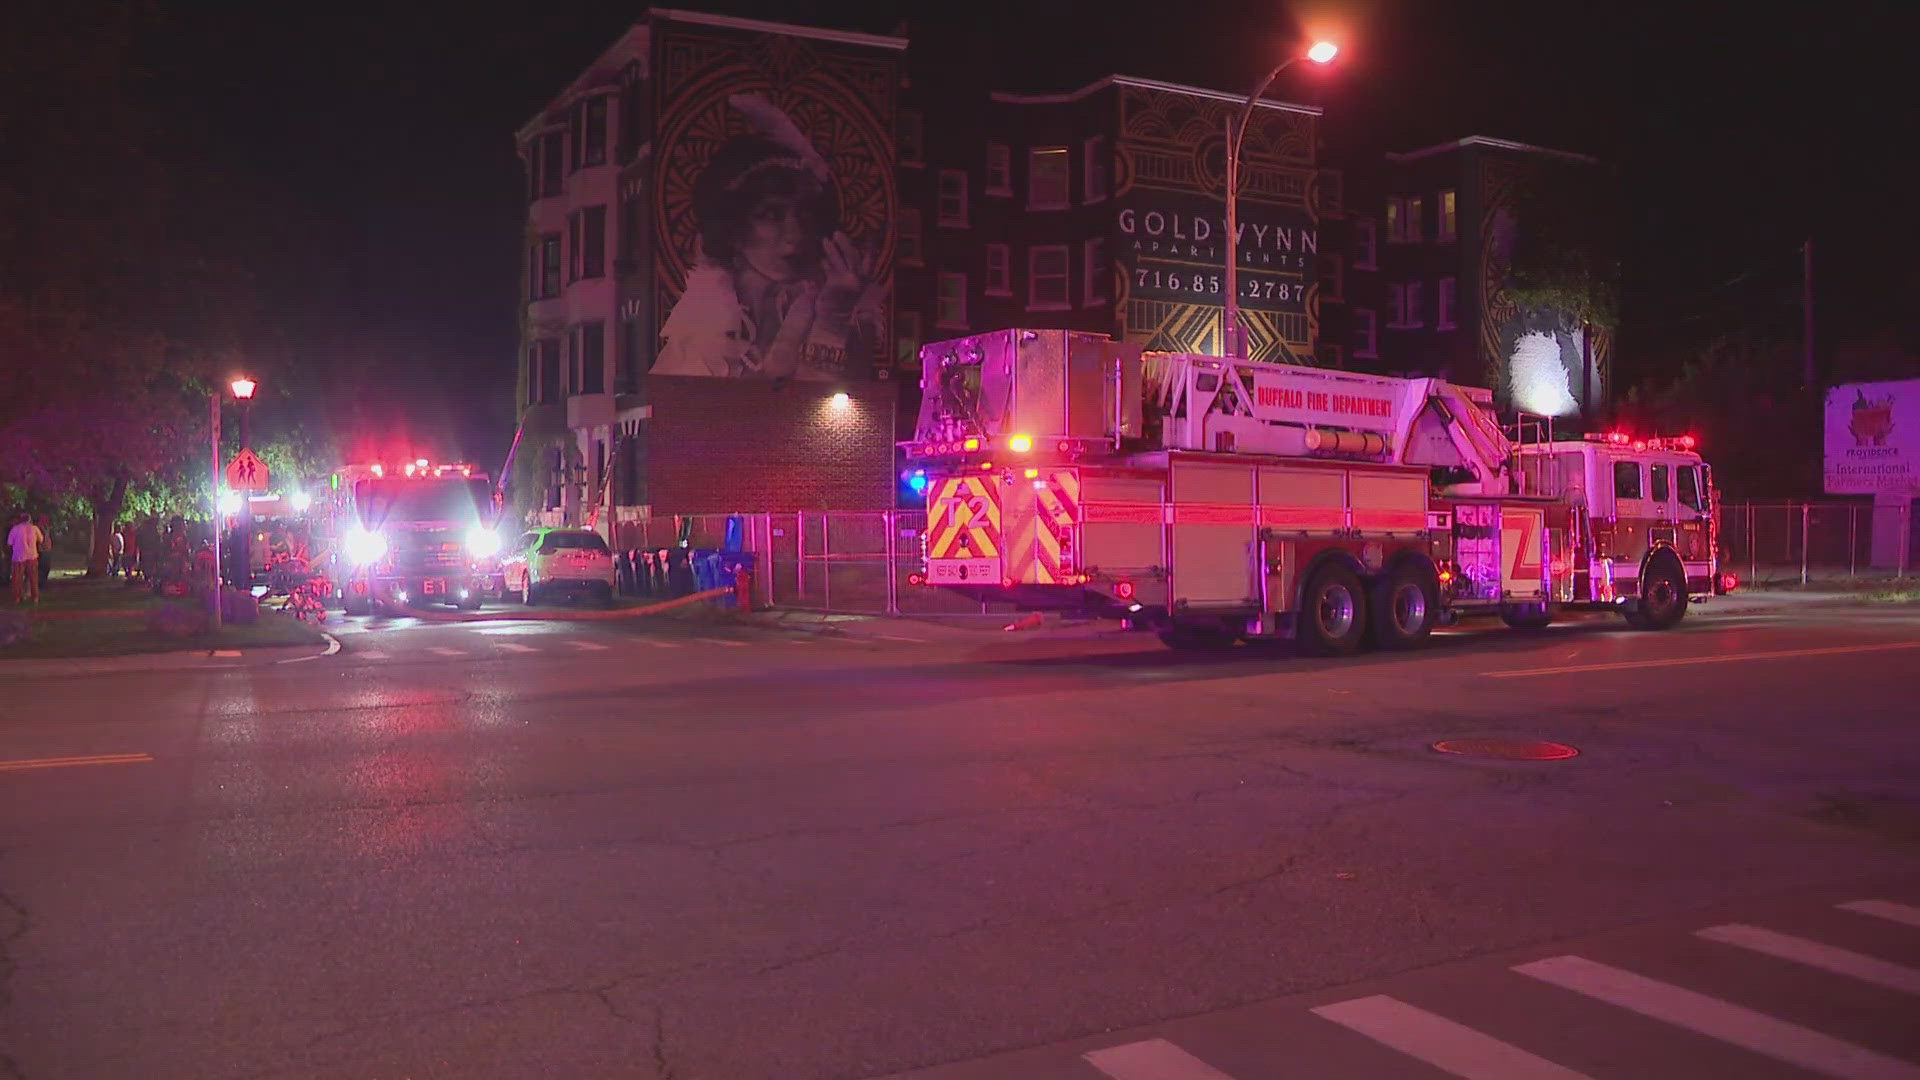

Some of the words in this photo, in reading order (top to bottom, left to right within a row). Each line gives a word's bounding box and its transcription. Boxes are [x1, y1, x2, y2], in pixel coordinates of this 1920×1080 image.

[1134, 239, 1305, 268] APARTENTS
[1135, 269, 1305, 302] 716.85.2787
[1258, 386, 1303, 409] BUFFALO
[1307, 391, 1329, 412] FIRE
[1333, 394, 1392, 418] DEPARTMENT
[1836, 460, 1910, 475] International
